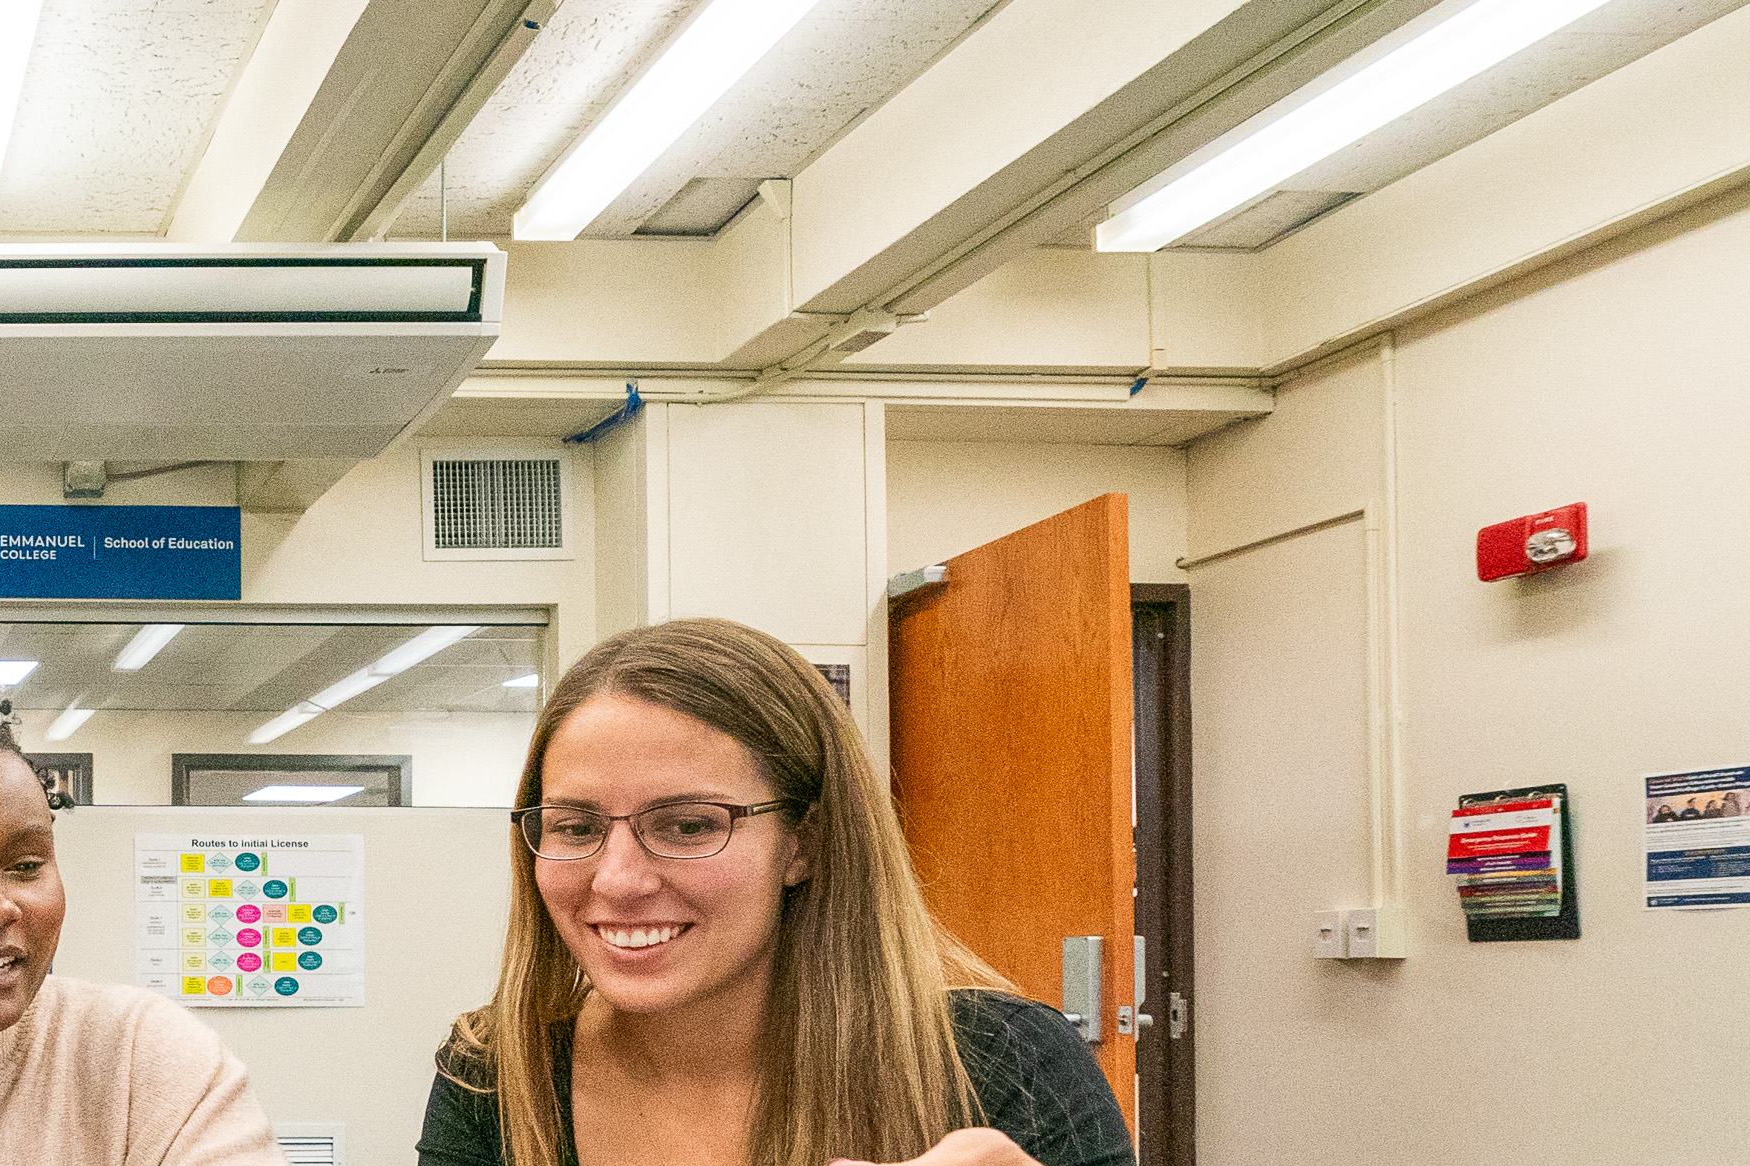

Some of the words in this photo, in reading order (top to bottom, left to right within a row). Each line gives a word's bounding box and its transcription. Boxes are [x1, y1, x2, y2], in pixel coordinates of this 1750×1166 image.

[0, 535, 85, 548] EMMANUEL
[104, 536, 149, 549] School
[152, 537, 166, 549] of
[168, 537, 234, 550] Education
[0, 549, 57, 560] COLLEGE
[191, 838, 226, 848] Routes
[229, 838, 239, 848] to
[241, 838, 268, 848] Initial
[271, 838, 309, 848] License
